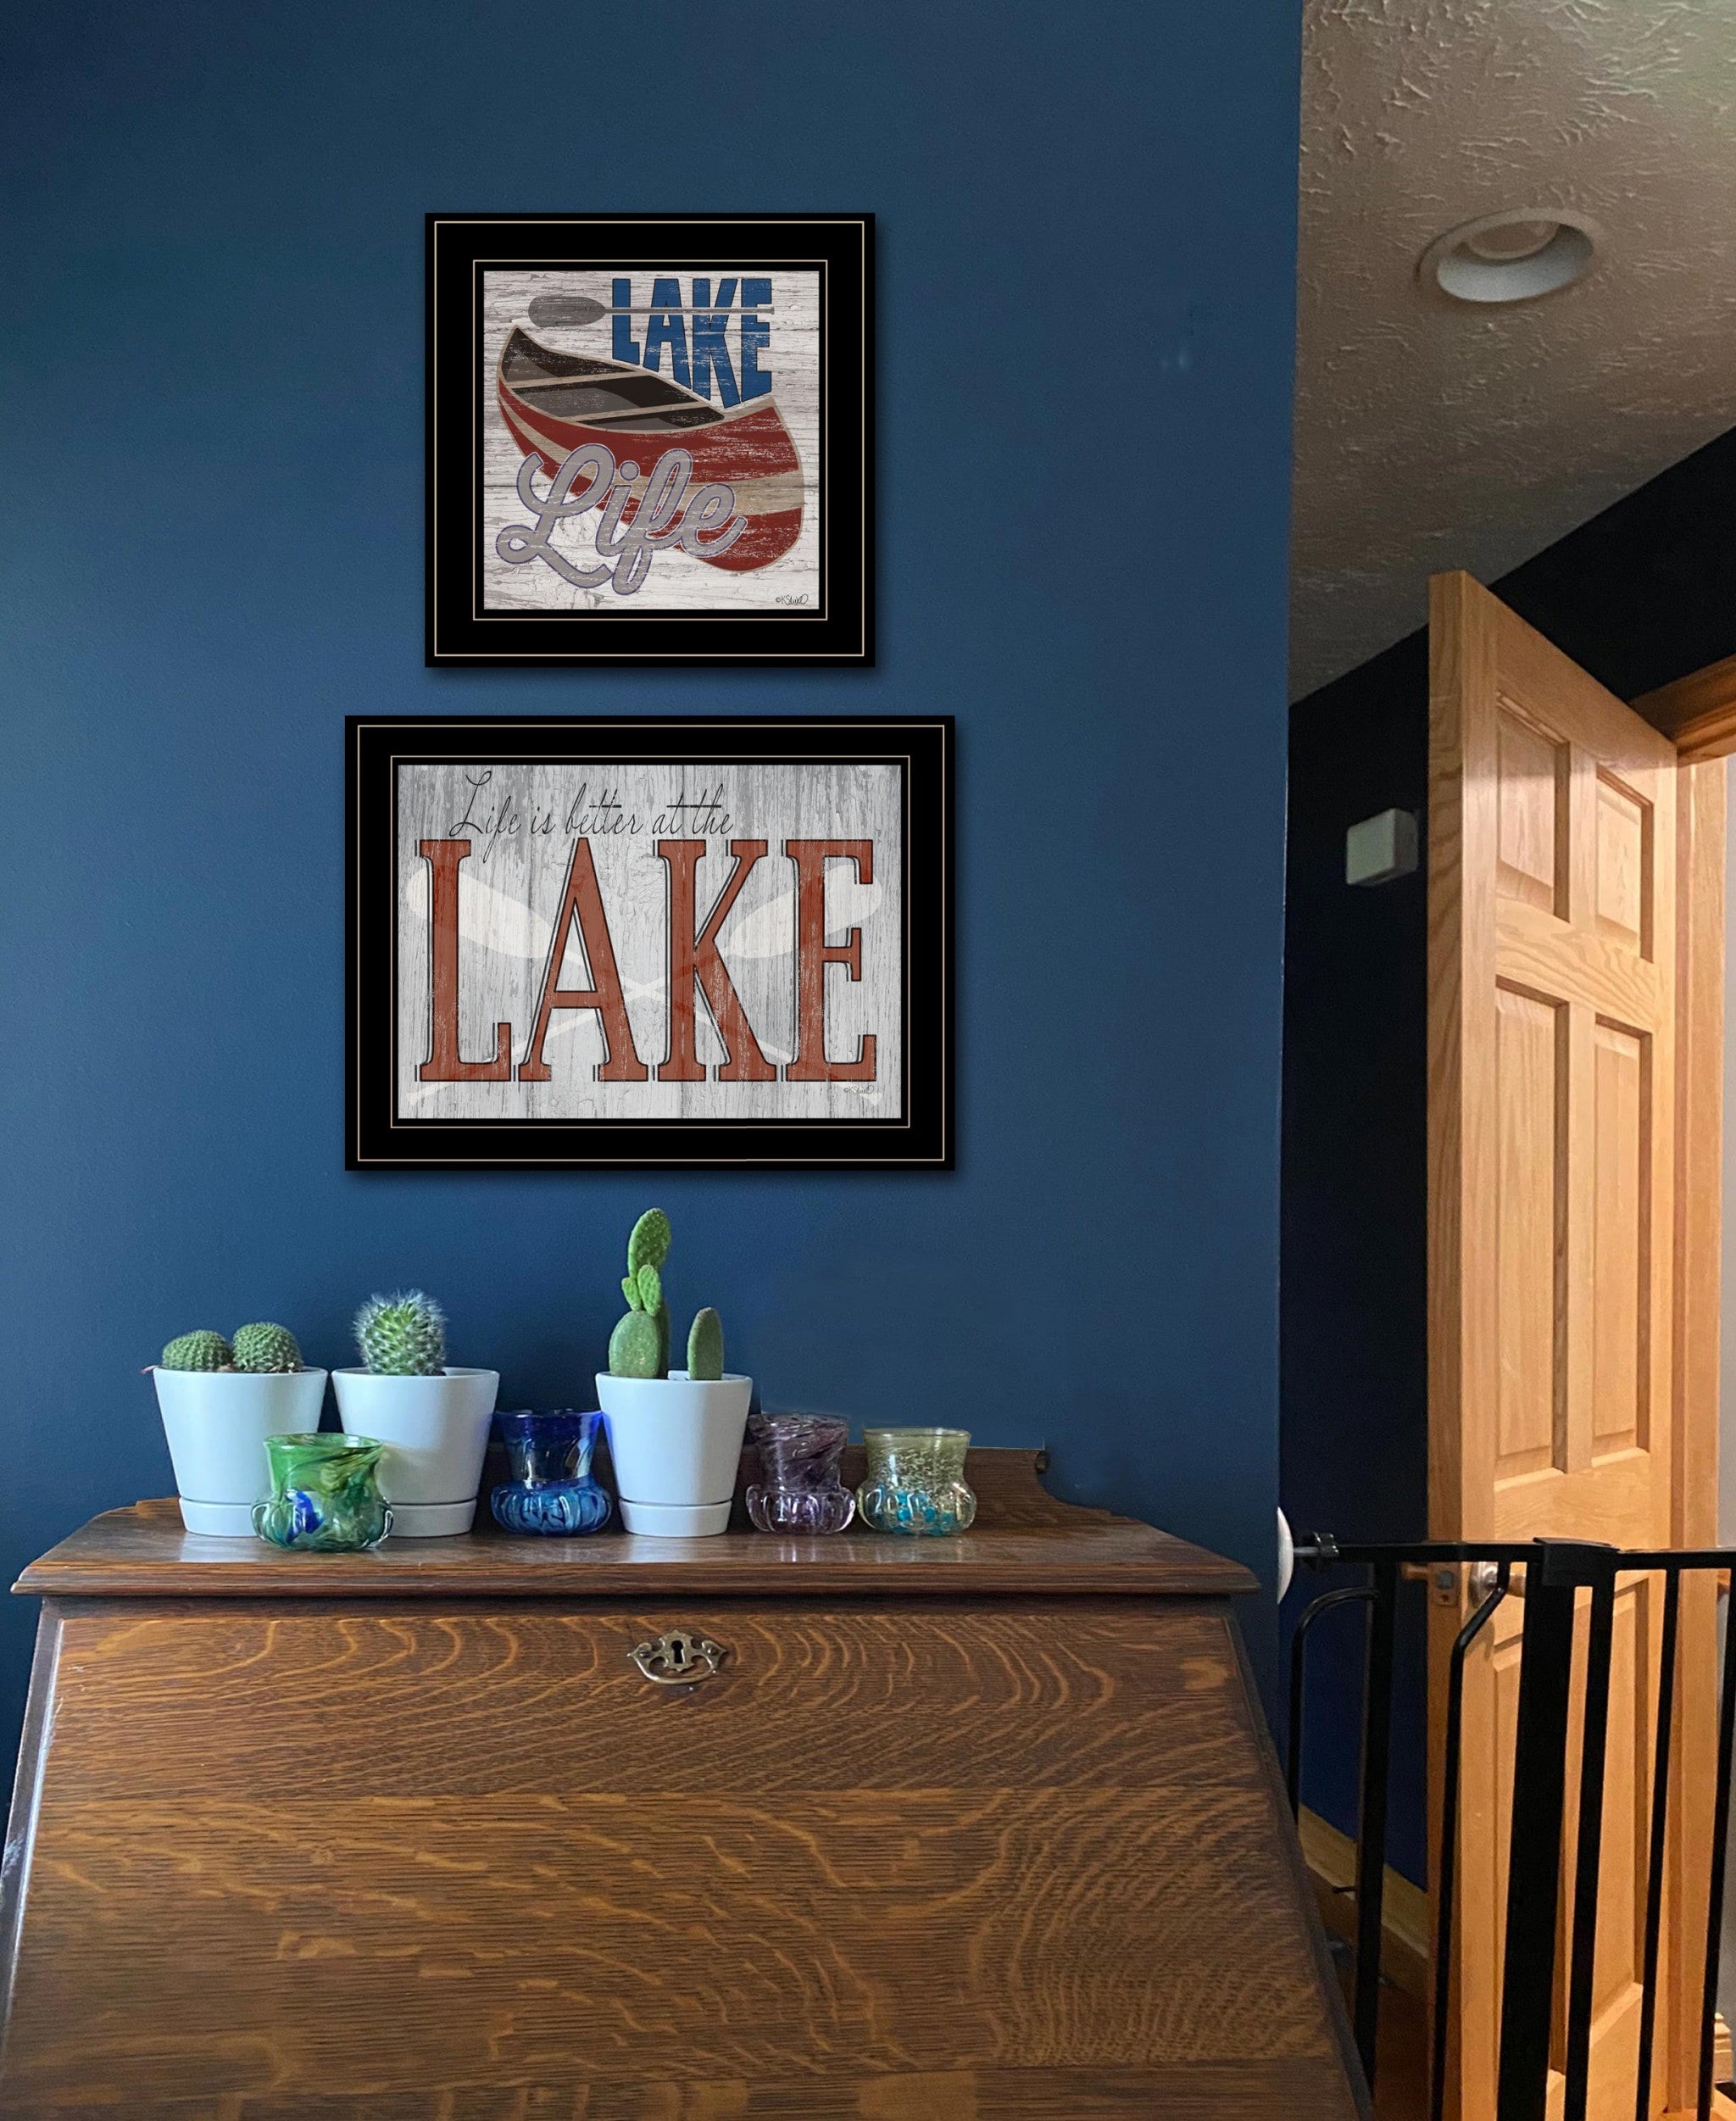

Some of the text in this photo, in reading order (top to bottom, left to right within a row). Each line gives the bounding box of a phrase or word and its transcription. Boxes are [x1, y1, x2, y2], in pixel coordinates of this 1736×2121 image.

[611, 278, 772, 409] LAKE
[495, 443, 748, 595] Life
[448, 771, 734, 863] Life is better at the
[414, 837, 877, 1082] LAKE
